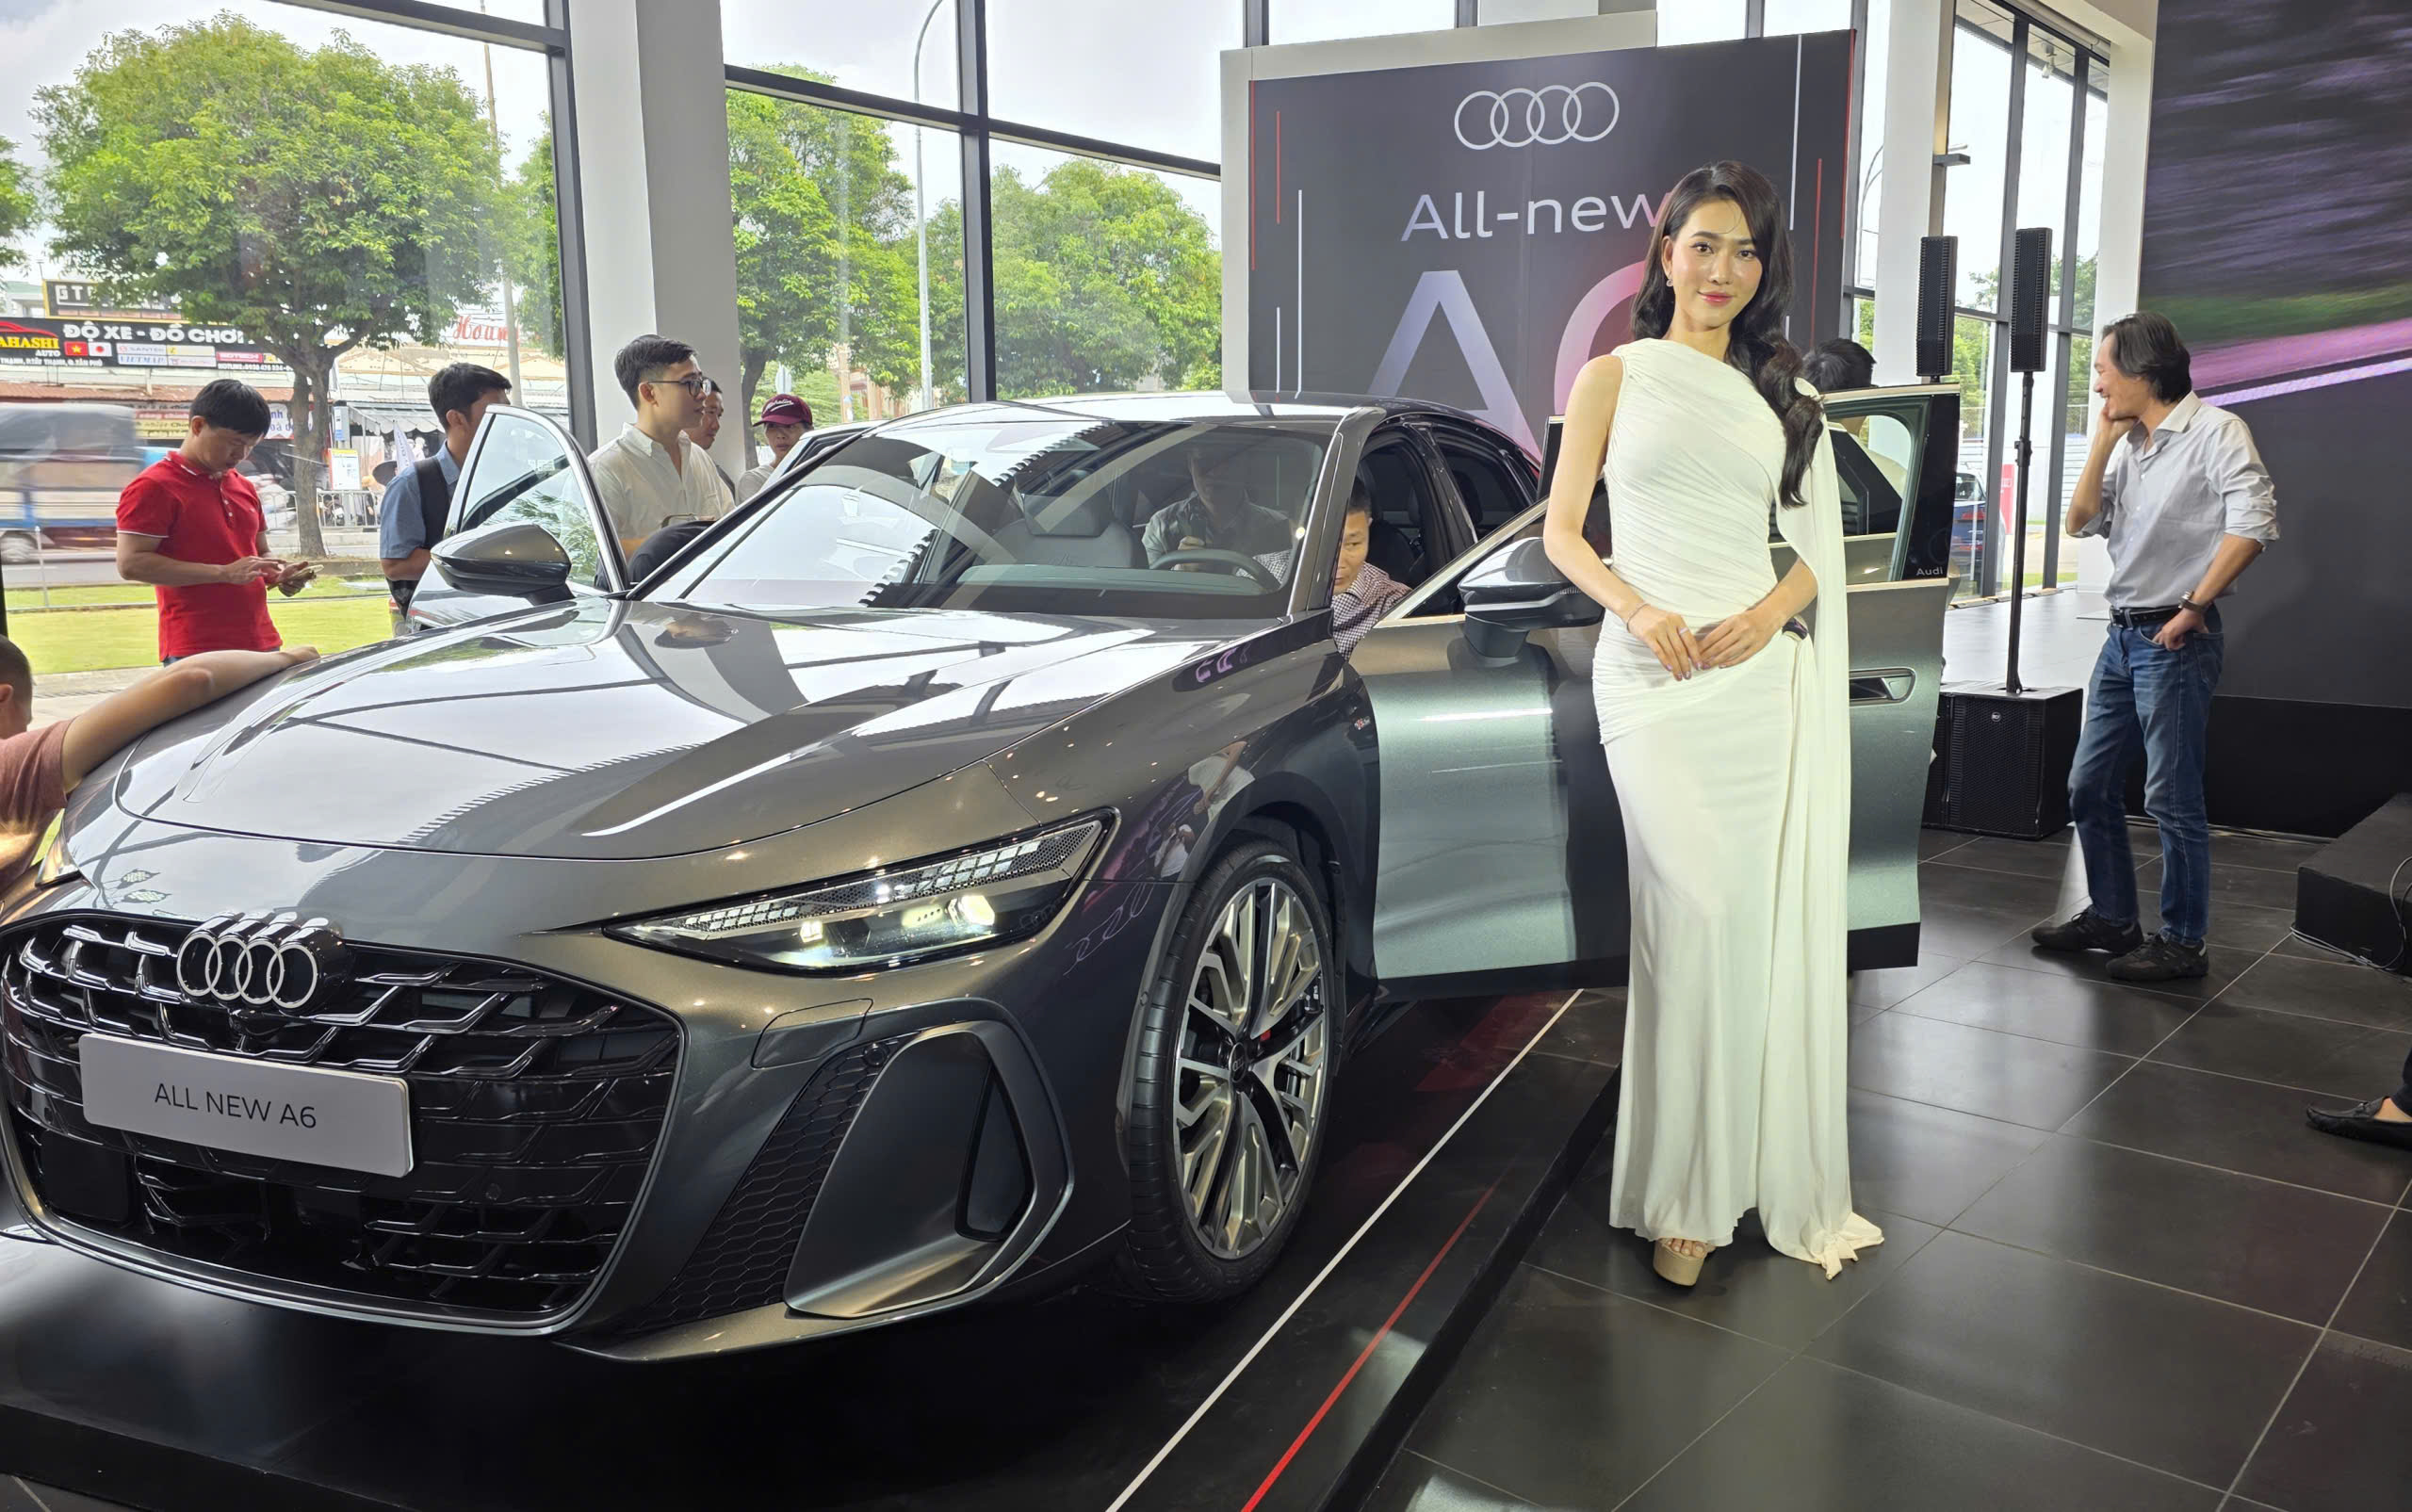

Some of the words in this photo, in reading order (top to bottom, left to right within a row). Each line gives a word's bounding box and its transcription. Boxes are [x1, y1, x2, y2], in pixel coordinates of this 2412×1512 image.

[1400, 190, 1673, 242] All-new
[104, 325, 132, 340] XE
[1916, 567, 1944, 576] Audi
[155, 1083, 199, 1110] ALL
[206, 1091, 271, 1122] NEW
[280, 1103, 317, 1129] A6
